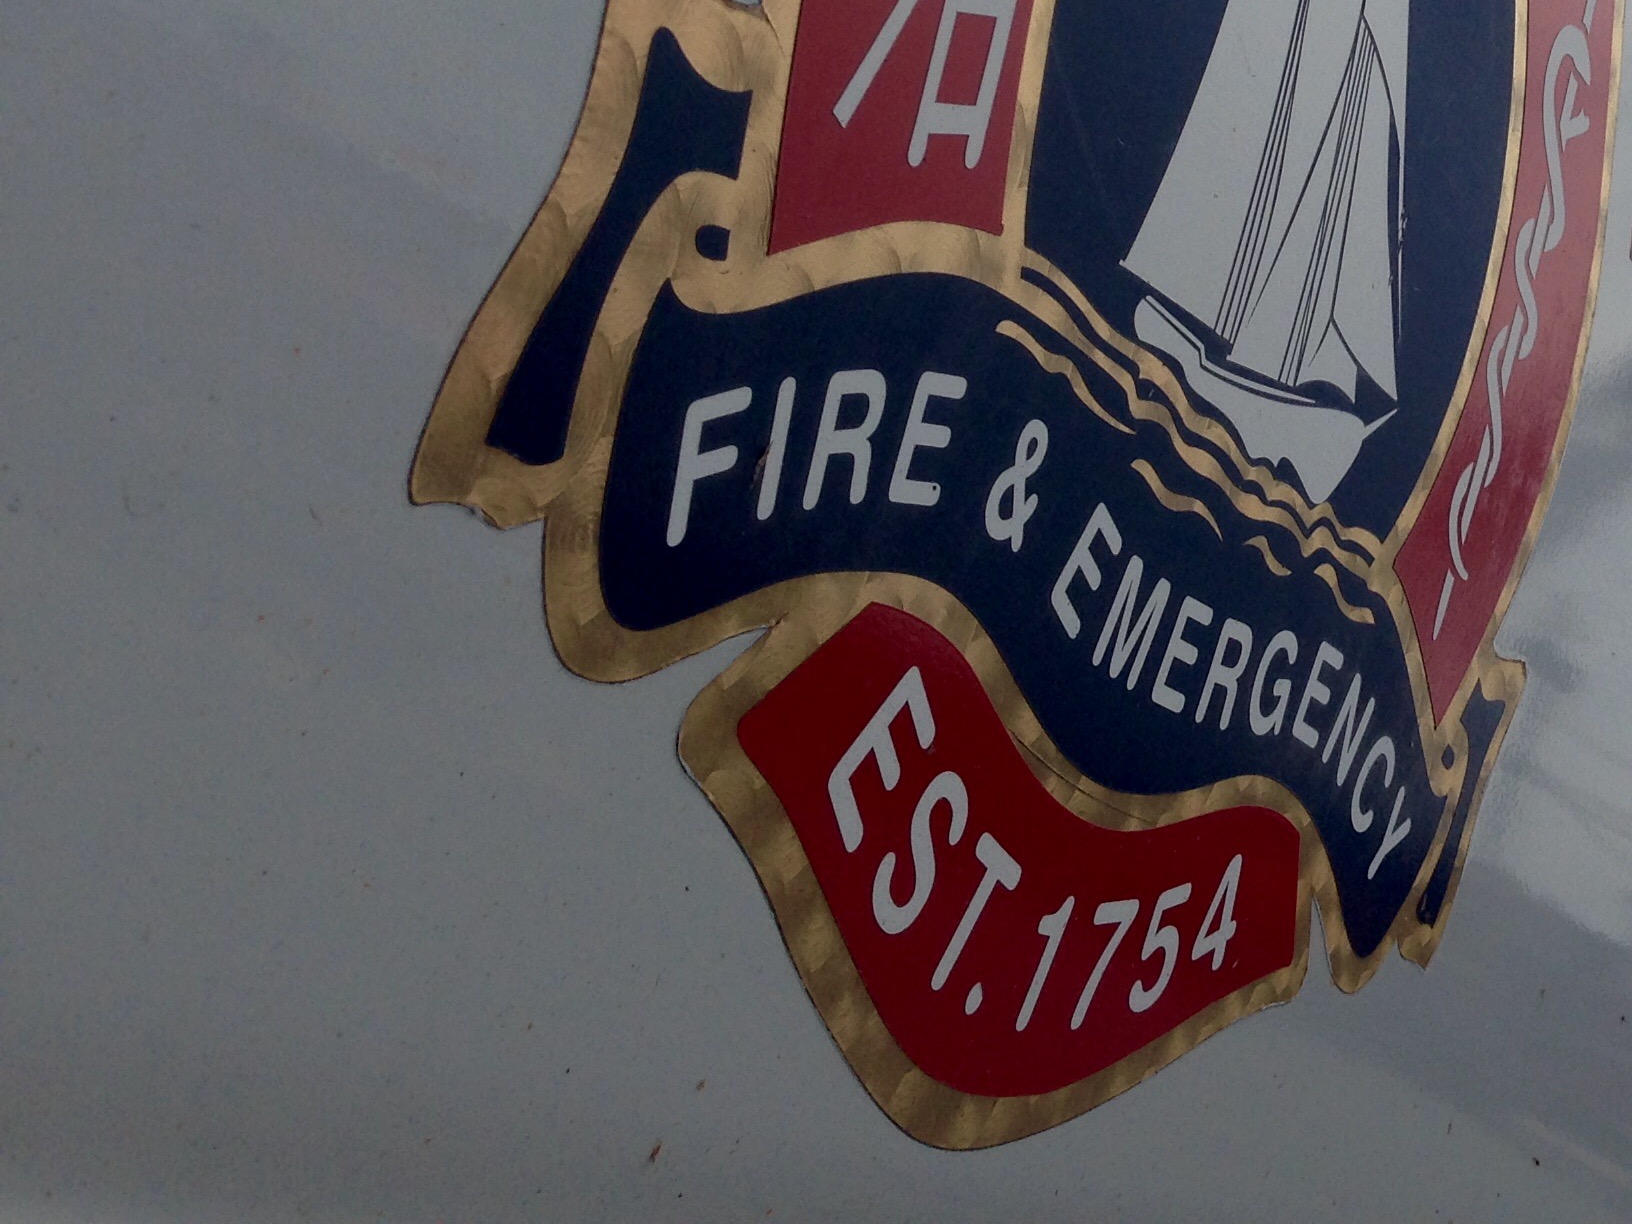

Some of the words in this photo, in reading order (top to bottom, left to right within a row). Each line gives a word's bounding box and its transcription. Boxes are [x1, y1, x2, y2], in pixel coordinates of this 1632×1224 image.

[666, 368, 969, 548] FIRE
[985, 418, 1050, 551] &
[1050, 502, 1413, 880] EMERGENCY
[827, 666, 1023, 1016] EST.
[1015, 853, 1244, 1033] 1754
